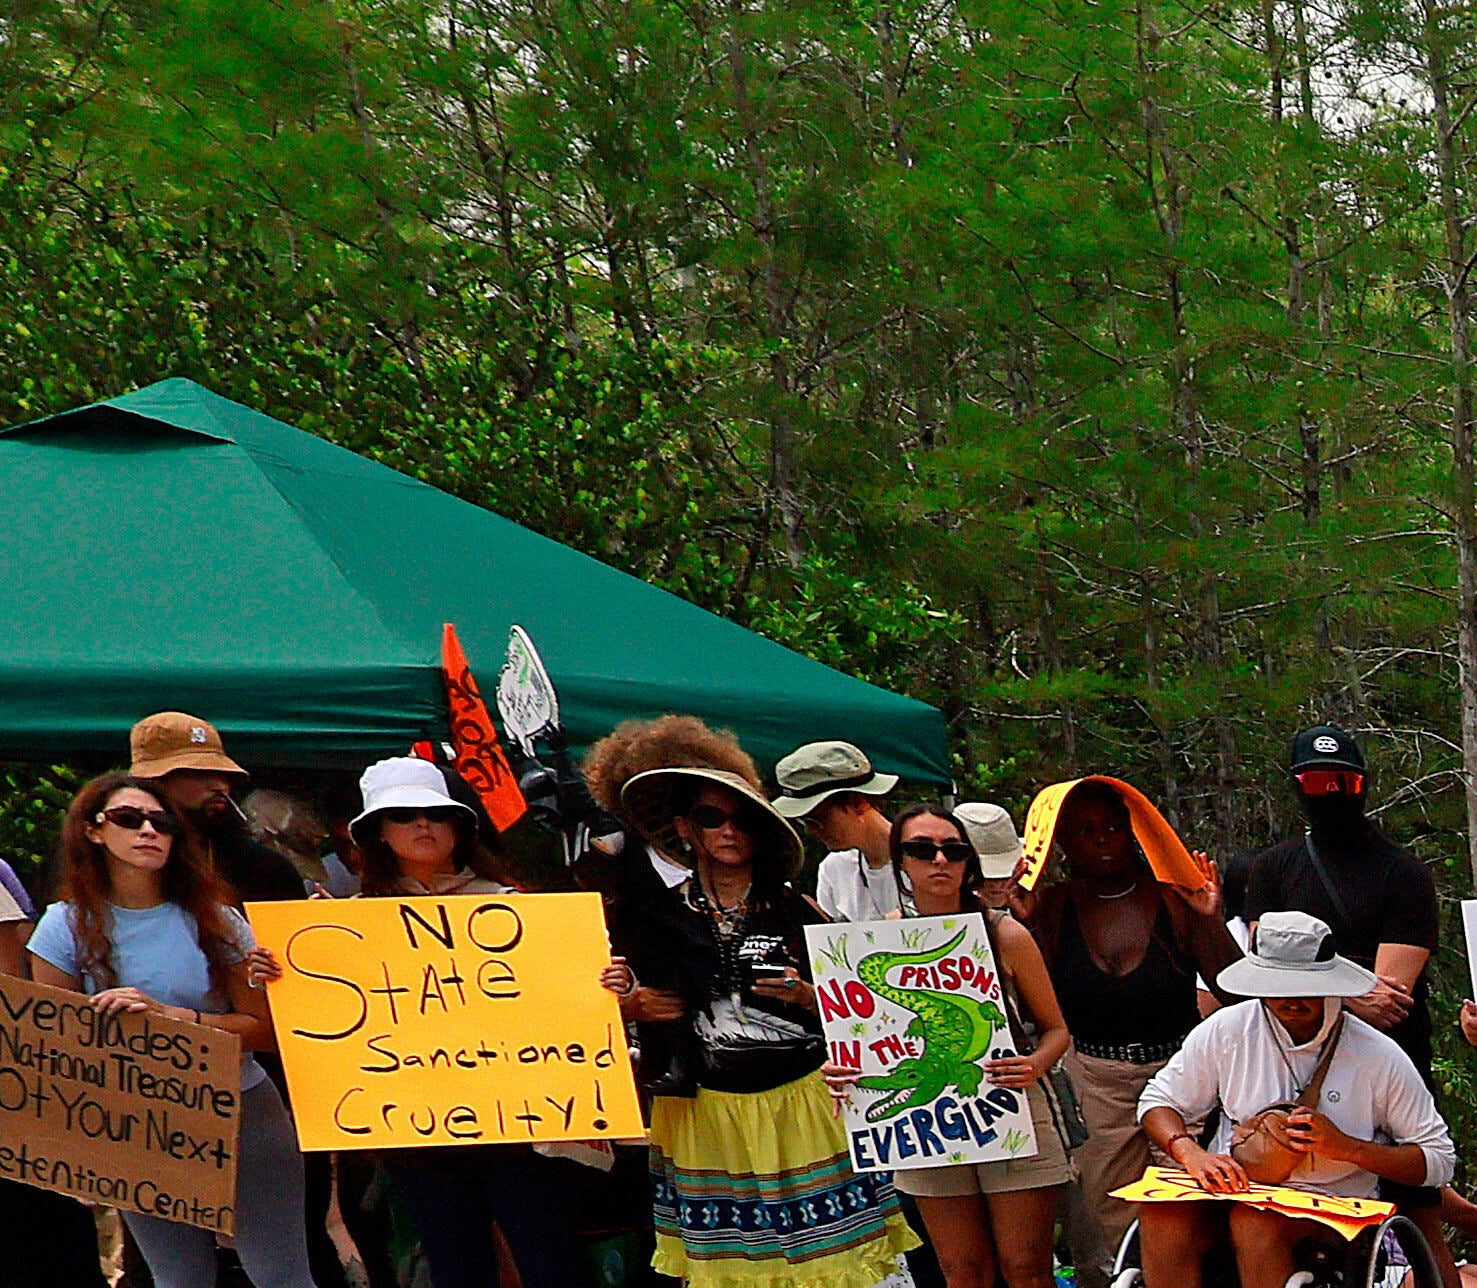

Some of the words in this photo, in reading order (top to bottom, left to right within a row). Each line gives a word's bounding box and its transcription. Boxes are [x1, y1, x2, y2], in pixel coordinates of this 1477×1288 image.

[400, 902, 523, 953] NO
[816, 977, 875, 1023] NO
[899, 956, 1002, 1001] PRISONS
[0, 988, 209, 1072] verglades:
[360, 1023, 617, 1073] Sanctioned
[829, 1039, 861, 1069] IN
[868, 1033, 921, 1066] THE
[0, 1023, 105, 1088] National
[110, 1053, 236, 1119] Treasure
[145, 1108, 232, 1170] Next
[333, 1079, 609, 1139] Cruelty!
[851, 1047, 1026, 1169] EVERGLAD
[0, 1143, 129, 1201] etention
[134, 1181, 234, 1230] Center
